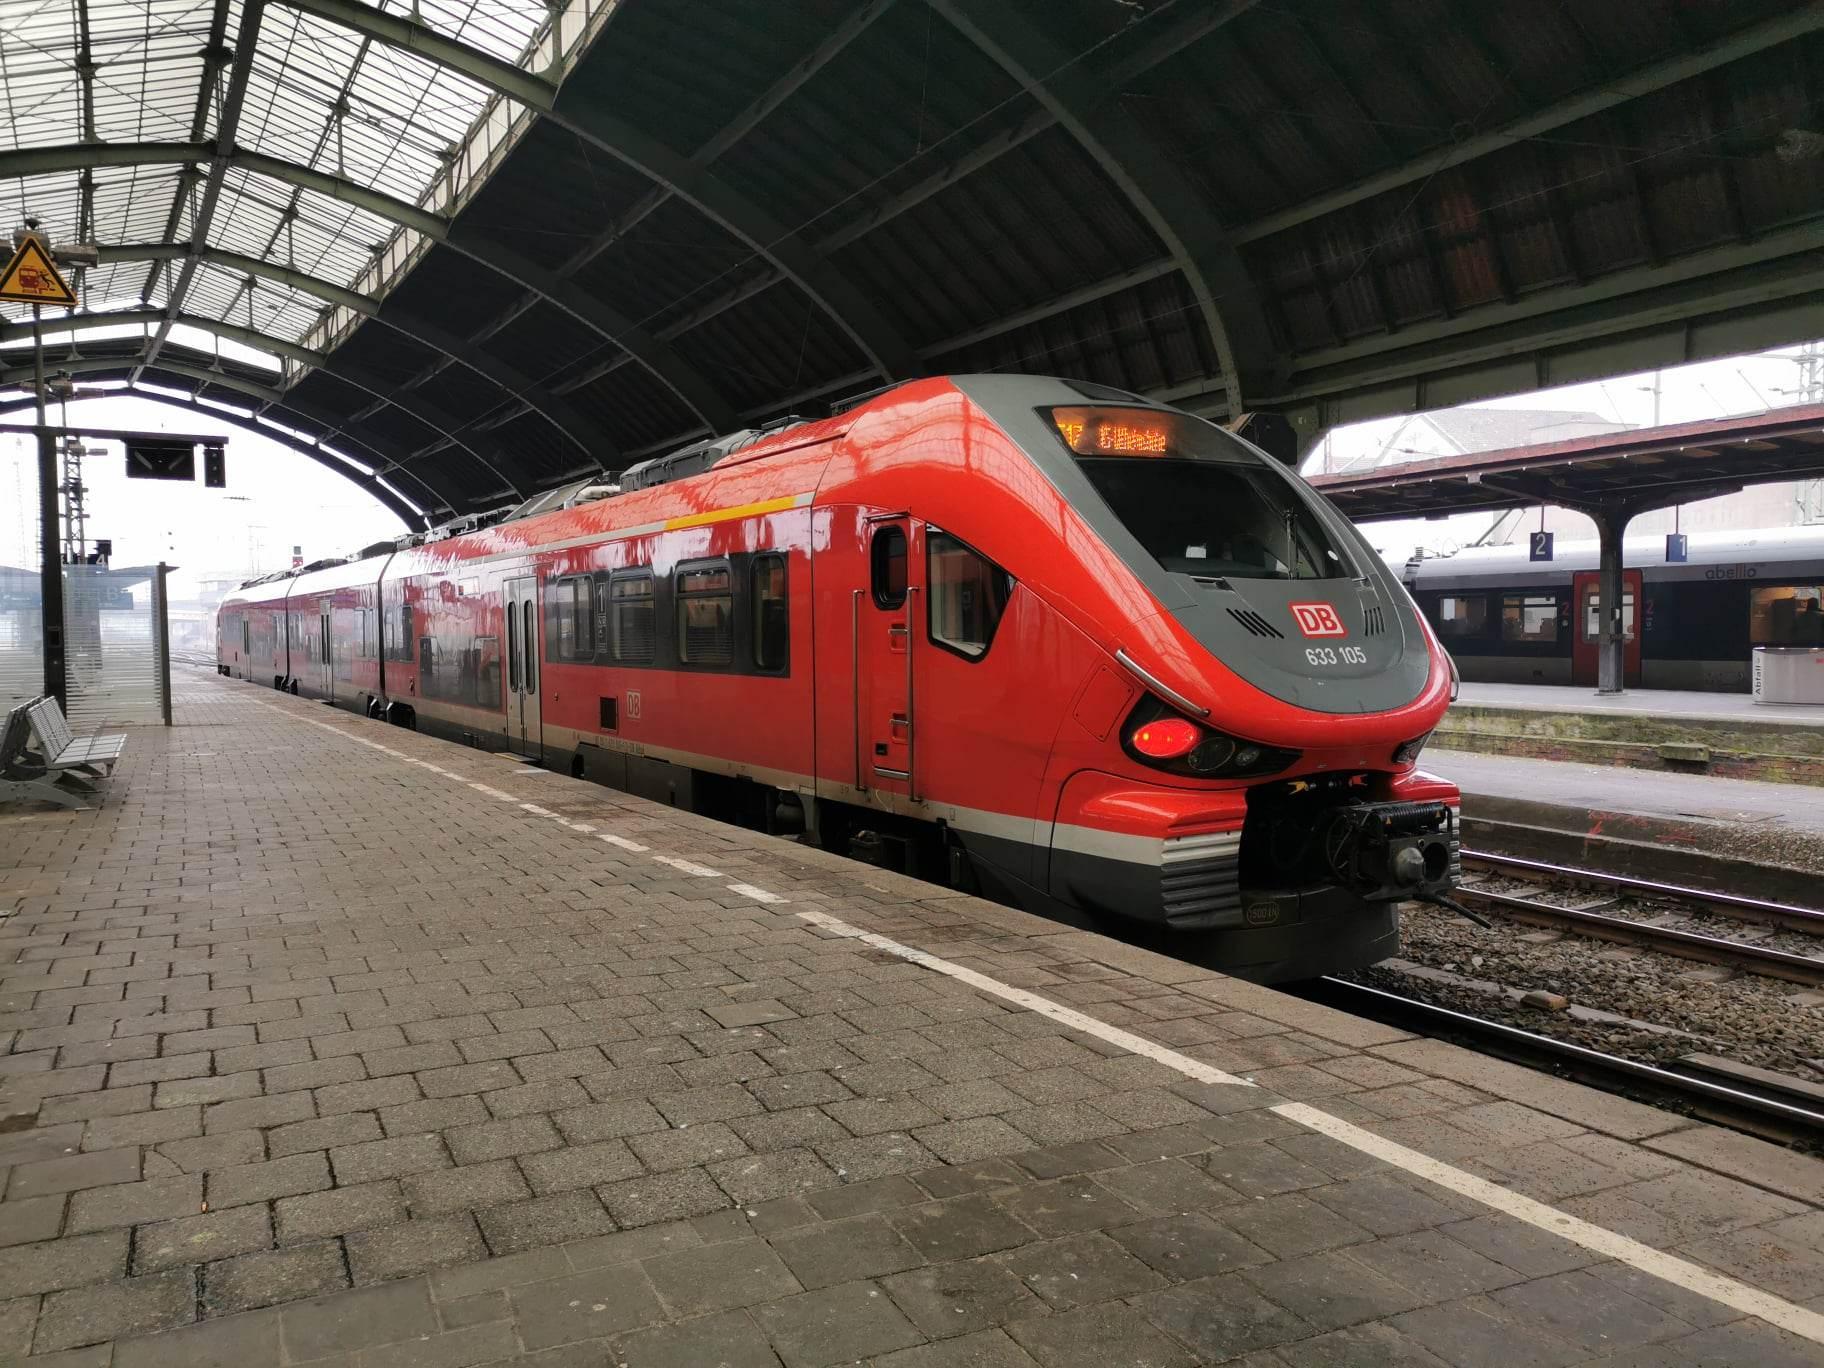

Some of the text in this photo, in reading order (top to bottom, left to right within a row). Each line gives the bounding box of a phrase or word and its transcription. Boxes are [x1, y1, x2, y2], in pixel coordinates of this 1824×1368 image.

[1535, 533, 1546, 555] 2
[1679, 537, 1686, 557] 1
[1705, 563, 1757, 579] abello
[1295, 606, 1339, 633] DB
[1305, 646, 1367, 666] 633 105
[627, 693, 640, 717] DB
